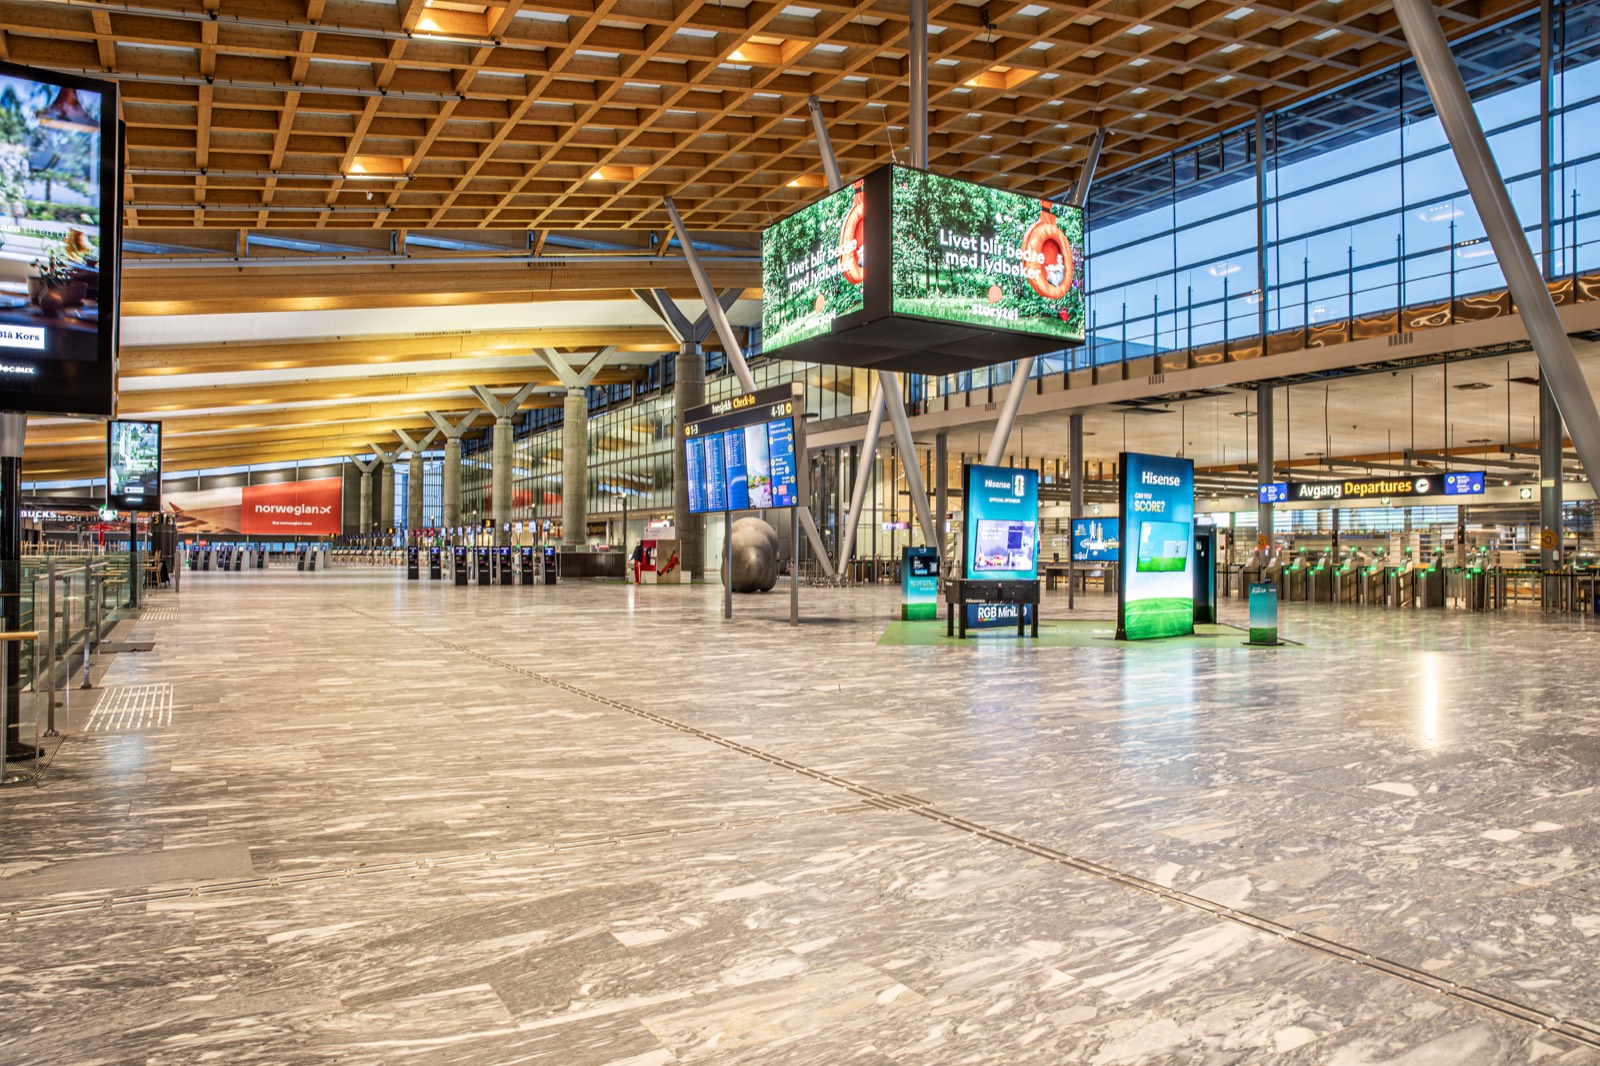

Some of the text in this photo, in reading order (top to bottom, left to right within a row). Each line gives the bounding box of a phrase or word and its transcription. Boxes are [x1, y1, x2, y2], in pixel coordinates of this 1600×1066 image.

[940, 228, 1045, 264] Livet blir bedre
[787, 238, 857, 279] Livet blir bedre
[946, 251, 1041, 279] med lydbøker
[789, 270, 809, 293] med
[972, 304, 1018, 320] storytel
[15, 331, 40, 341] Kors
[733, 394, 756, 408] Check-in
[985, 479, 1011, 489] Hisense
[1142, 471, 1181, 486] Hisense
[1299, 480, 1412, 499] Avgang Departures
[255, 504, 319, 516] norwegian
[1135, 500, 1166, 512] SCORE?
[20, 510, 57, 518] BUCKS
[978, 605, 1028, 619] RGB MiniLD
